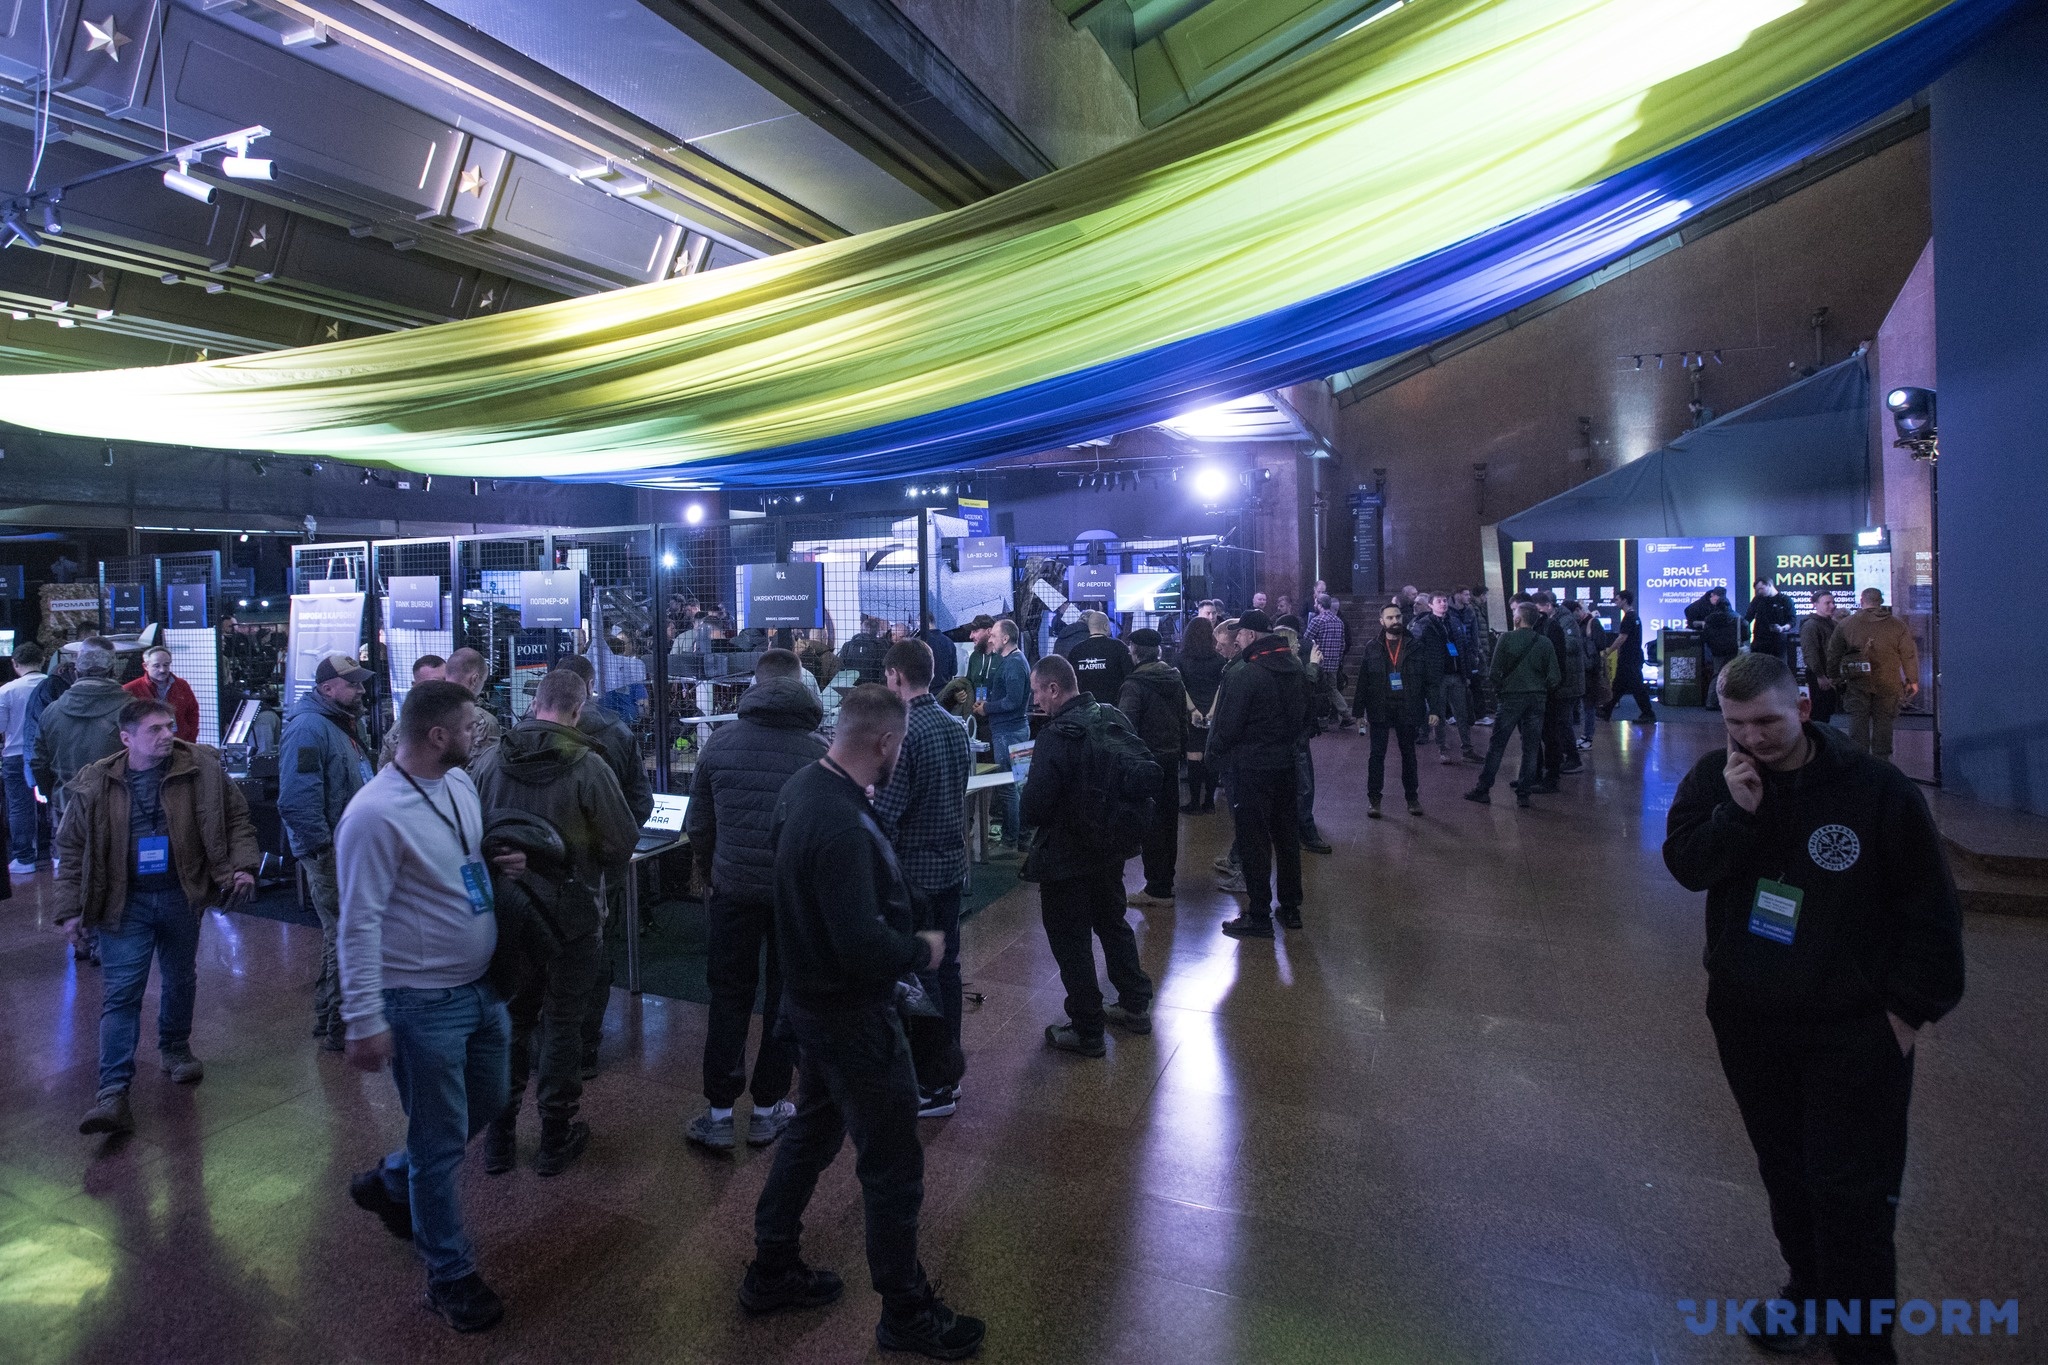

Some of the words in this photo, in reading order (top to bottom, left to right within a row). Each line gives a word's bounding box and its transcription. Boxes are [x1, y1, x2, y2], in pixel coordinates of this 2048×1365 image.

[1547, 558, 1590, 568] BECOME
[1776, 553, 1853, 568] BRAVE1
[1529, 570, 1549, 579] THE
[1551, 570, 1585, 579] BRAVE
[1587, 569, 1609, 578] ONE
[1663, 563, 1710, 577] BRAVE1
[1646, 577, 1728, 588] COMPONENTS
[1775, 572, 1854, 586] MARKET
[394, 600, 410, 608] TANK
[410, 600, 434, 609] BUREAU
[530, 597, 569, 605] ПОЛІМЕР-СМ
